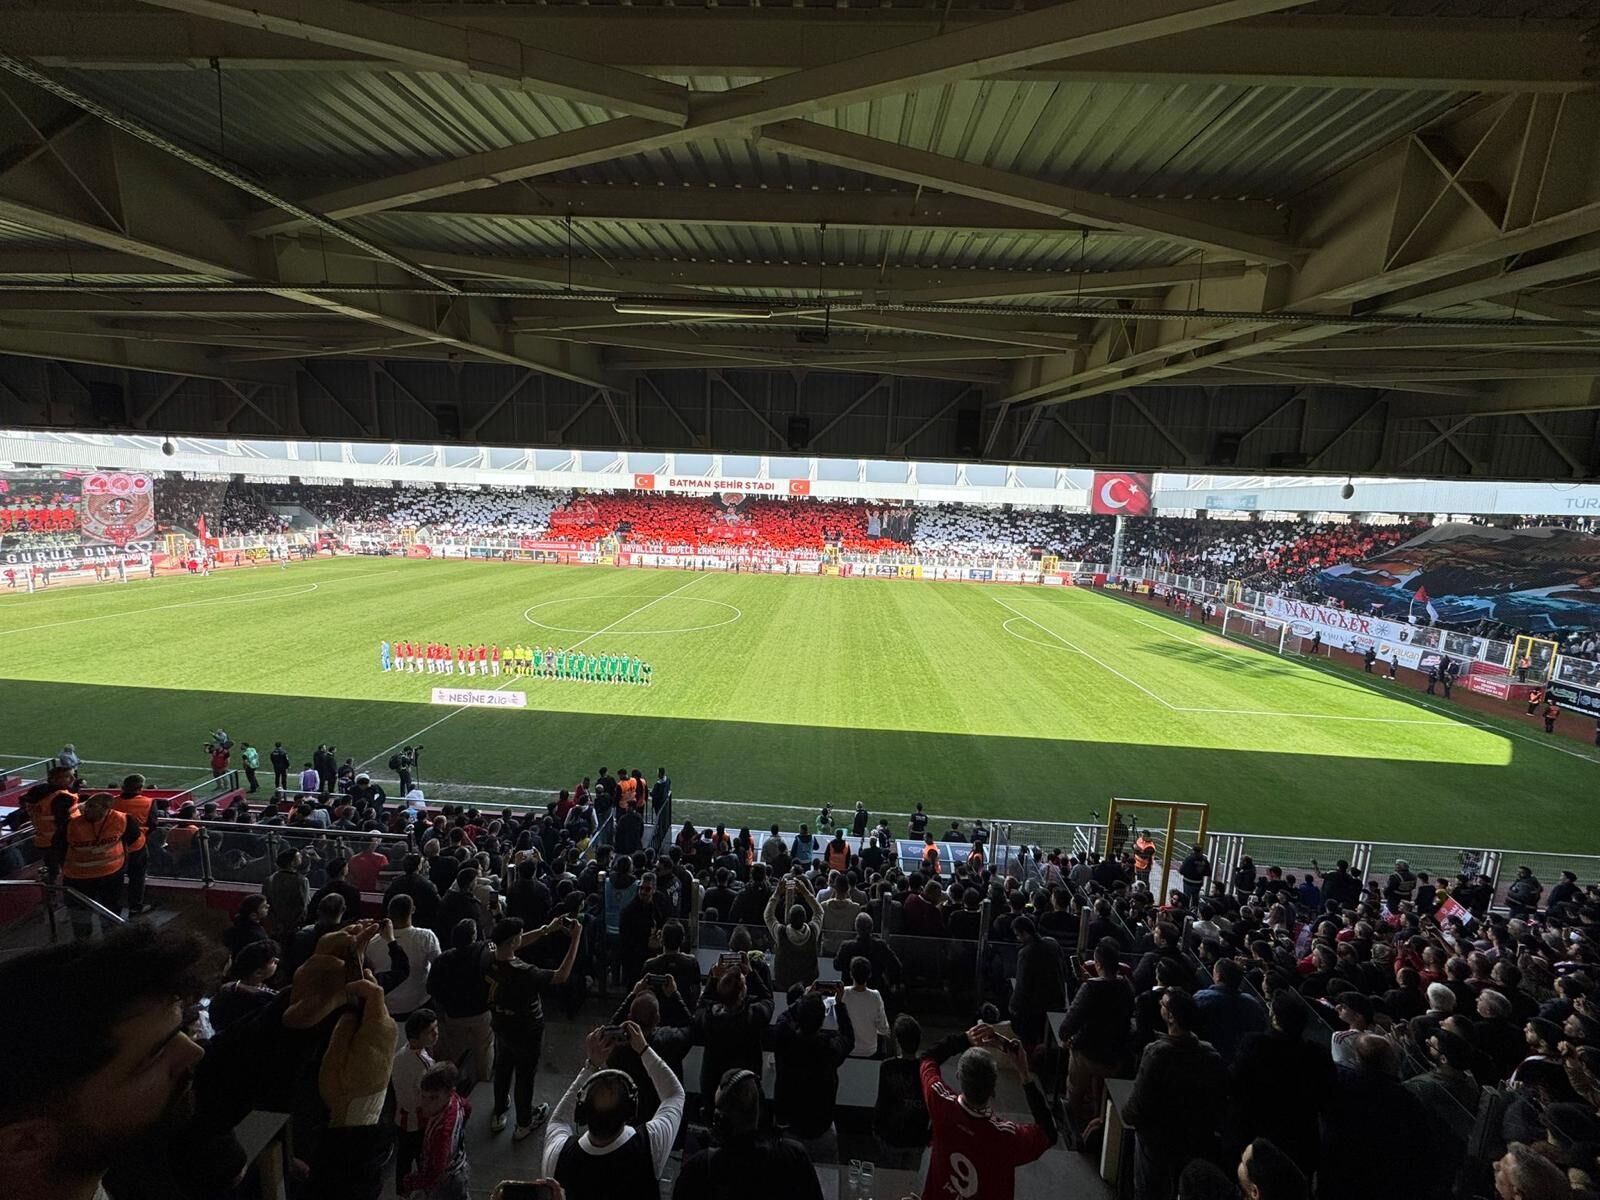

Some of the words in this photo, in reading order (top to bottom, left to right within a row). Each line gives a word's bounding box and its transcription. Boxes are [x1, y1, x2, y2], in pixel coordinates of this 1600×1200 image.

[669, 479, 711, 488] BATMAN
[714, 480, 743, 490] ŞEHİR
[745, 482, 775, 491] STADI
[1565, 496, 1600, 509] TÜR
[449, 691, 485, 704] NESİNE
[949, 1152, 979, 1199] 9
